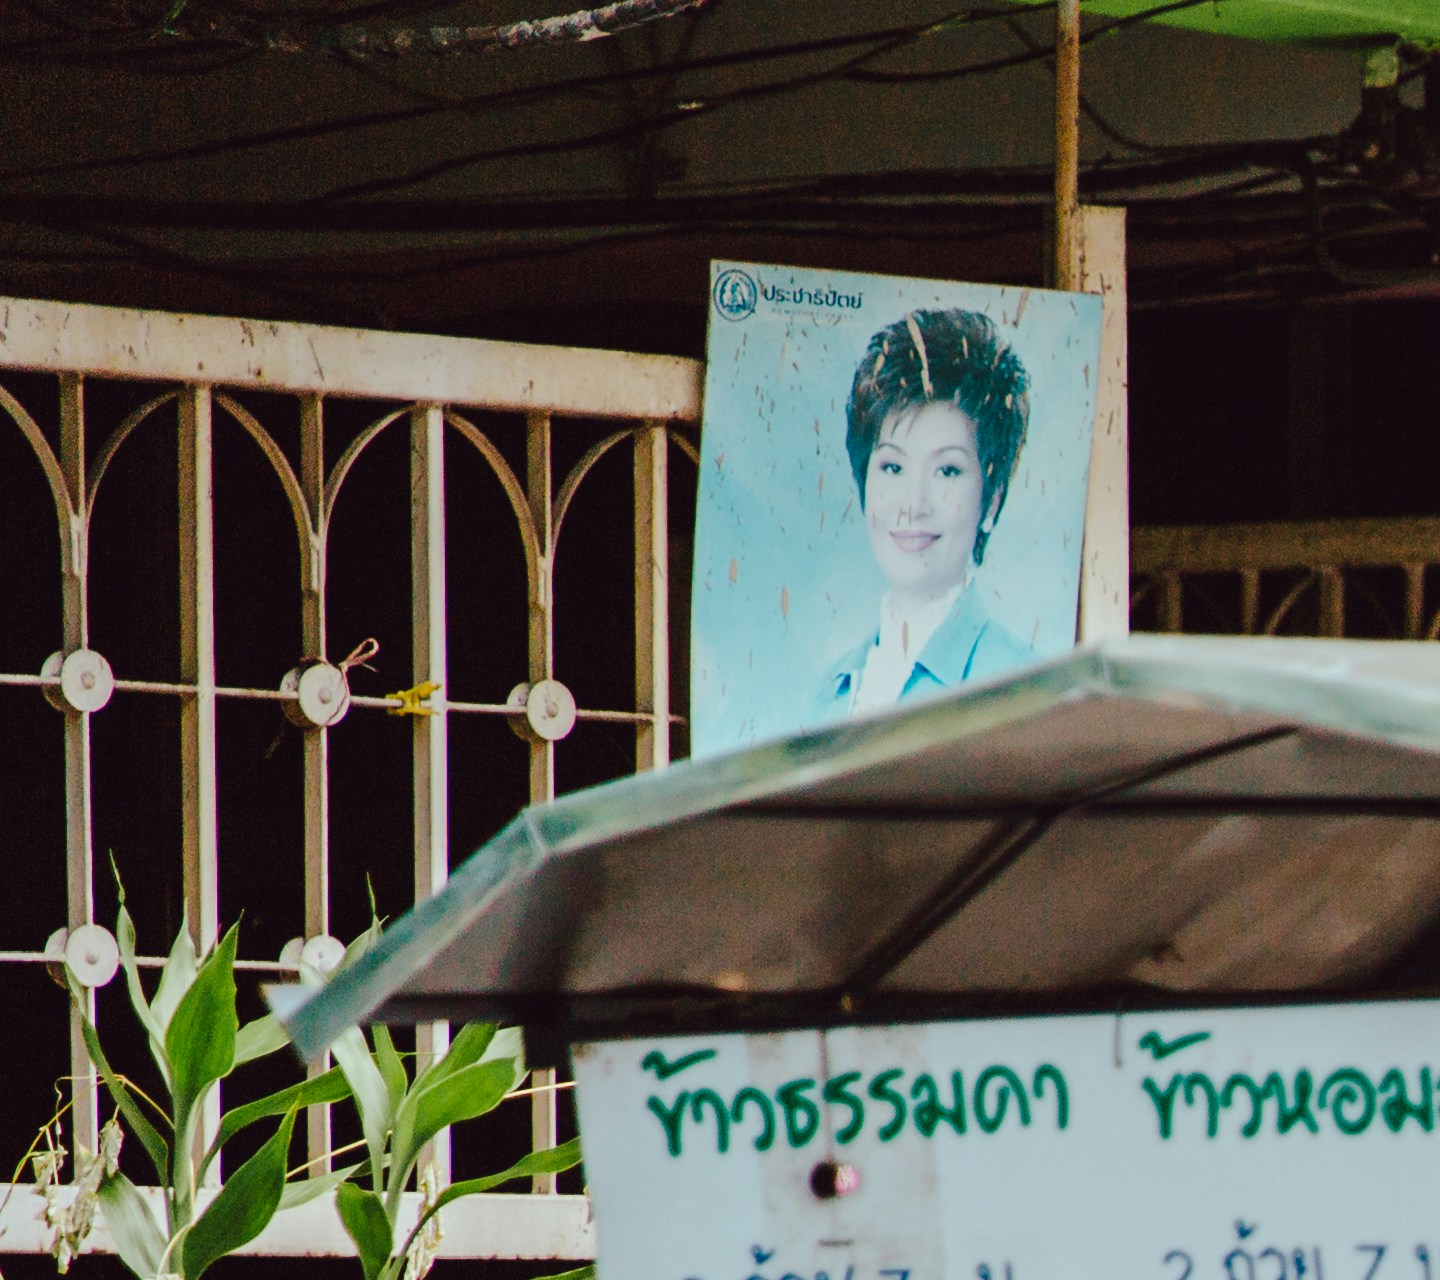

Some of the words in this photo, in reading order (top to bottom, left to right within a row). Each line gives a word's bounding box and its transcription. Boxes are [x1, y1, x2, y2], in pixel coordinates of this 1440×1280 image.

[763, 283, 865, 310] ประชาธิปัตย์
[641, 1047, 1070, 1157] ข้าวธรรมดา
